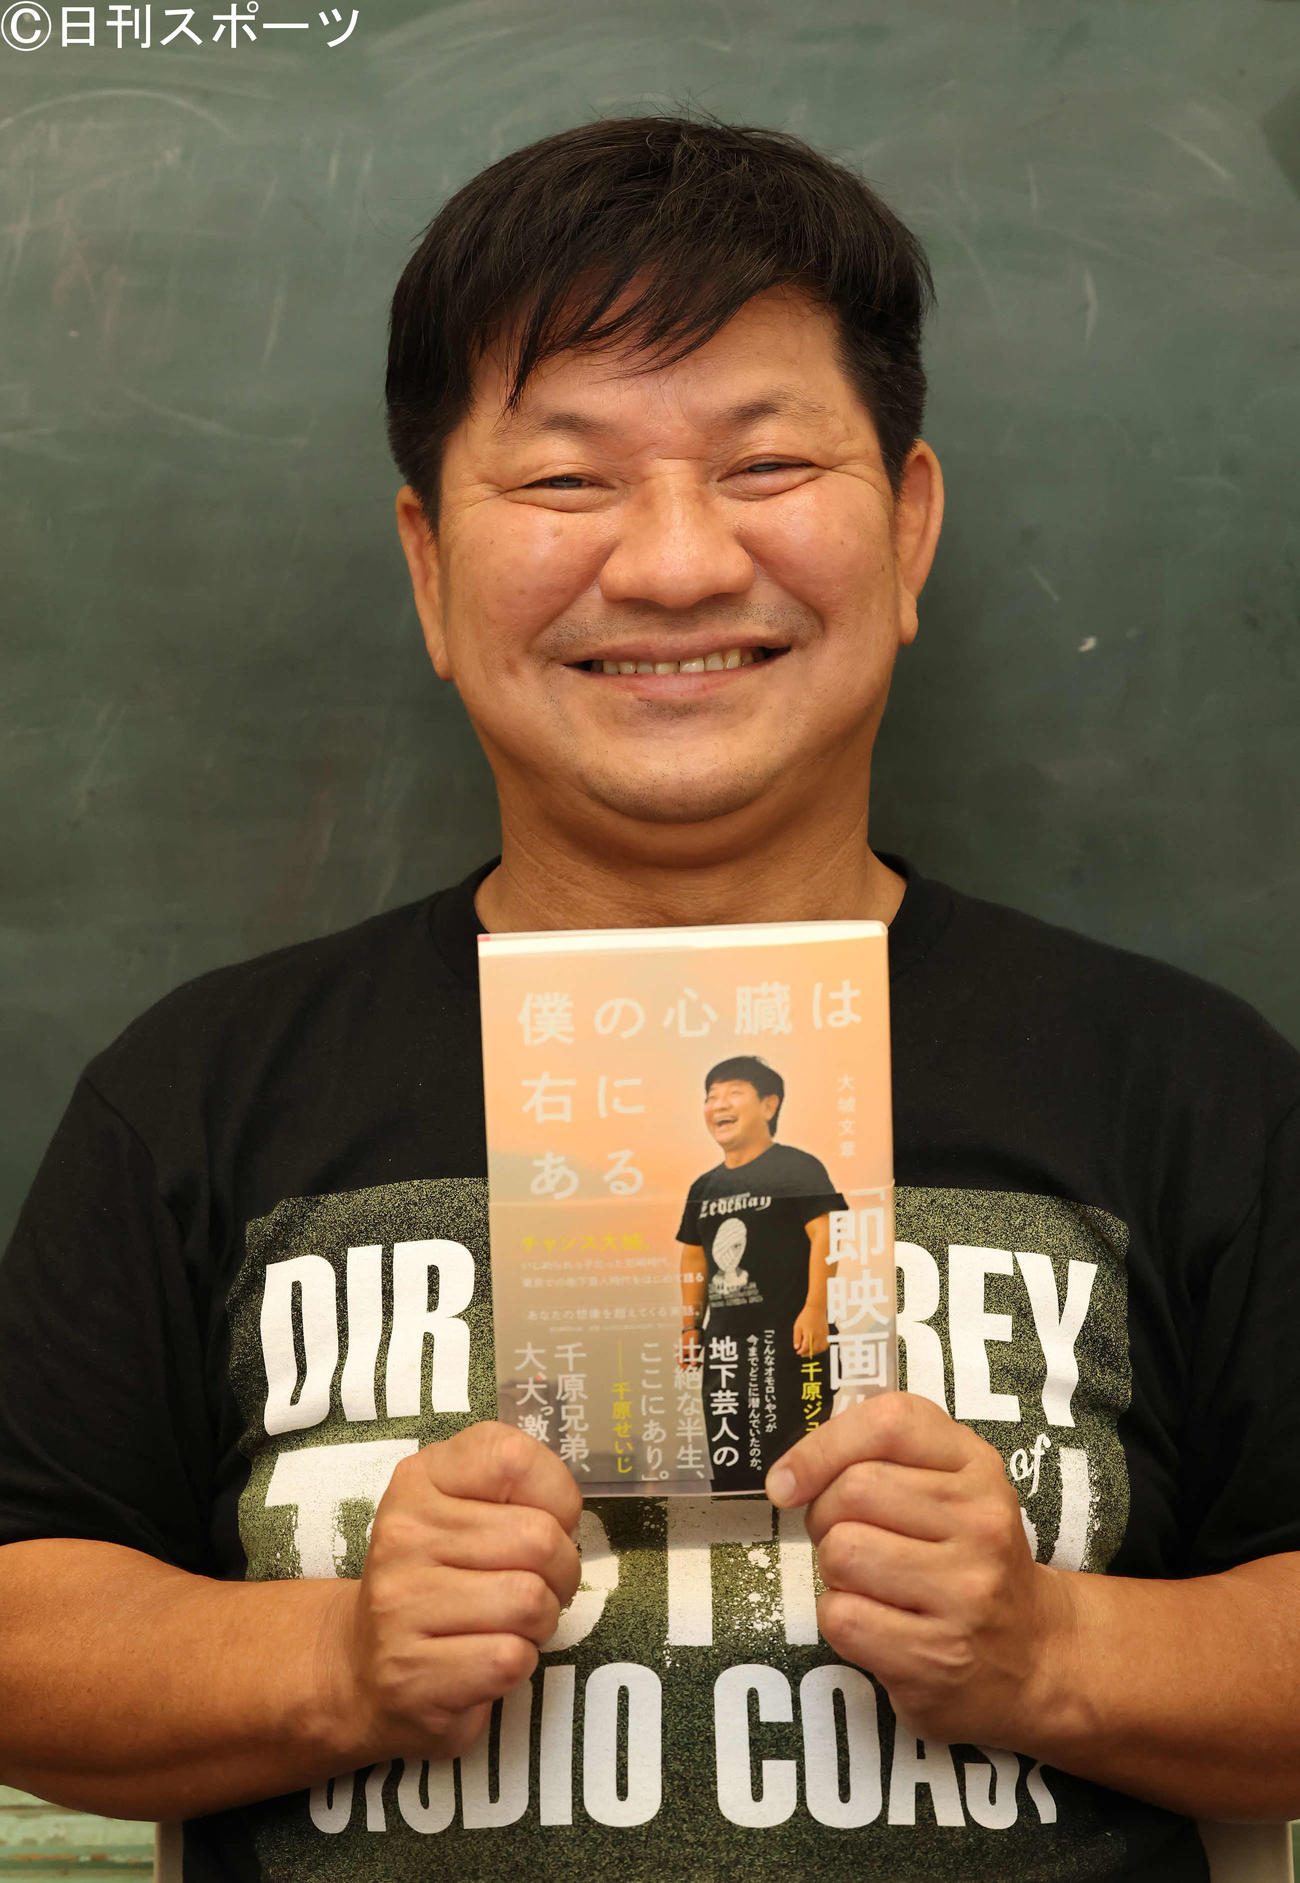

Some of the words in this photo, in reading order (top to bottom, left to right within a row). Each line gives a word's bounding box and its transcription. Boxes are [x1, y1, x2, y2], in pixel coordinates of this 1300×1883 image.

[517, 980, 863, 1045] 僕の心臓は
[521, 1071, 646, 1123] 右に
[529, 1149, 644, 1199] ある
[260, 1238, 476, 1436] DIR
[895, 1240, 1099, 1428] REY
[673, 1337, 706, 1479] 壮絶な半生、
[708, 1335, 740, 1468] 地下芸人の
[1009, 1433, 1051, 1499] of
